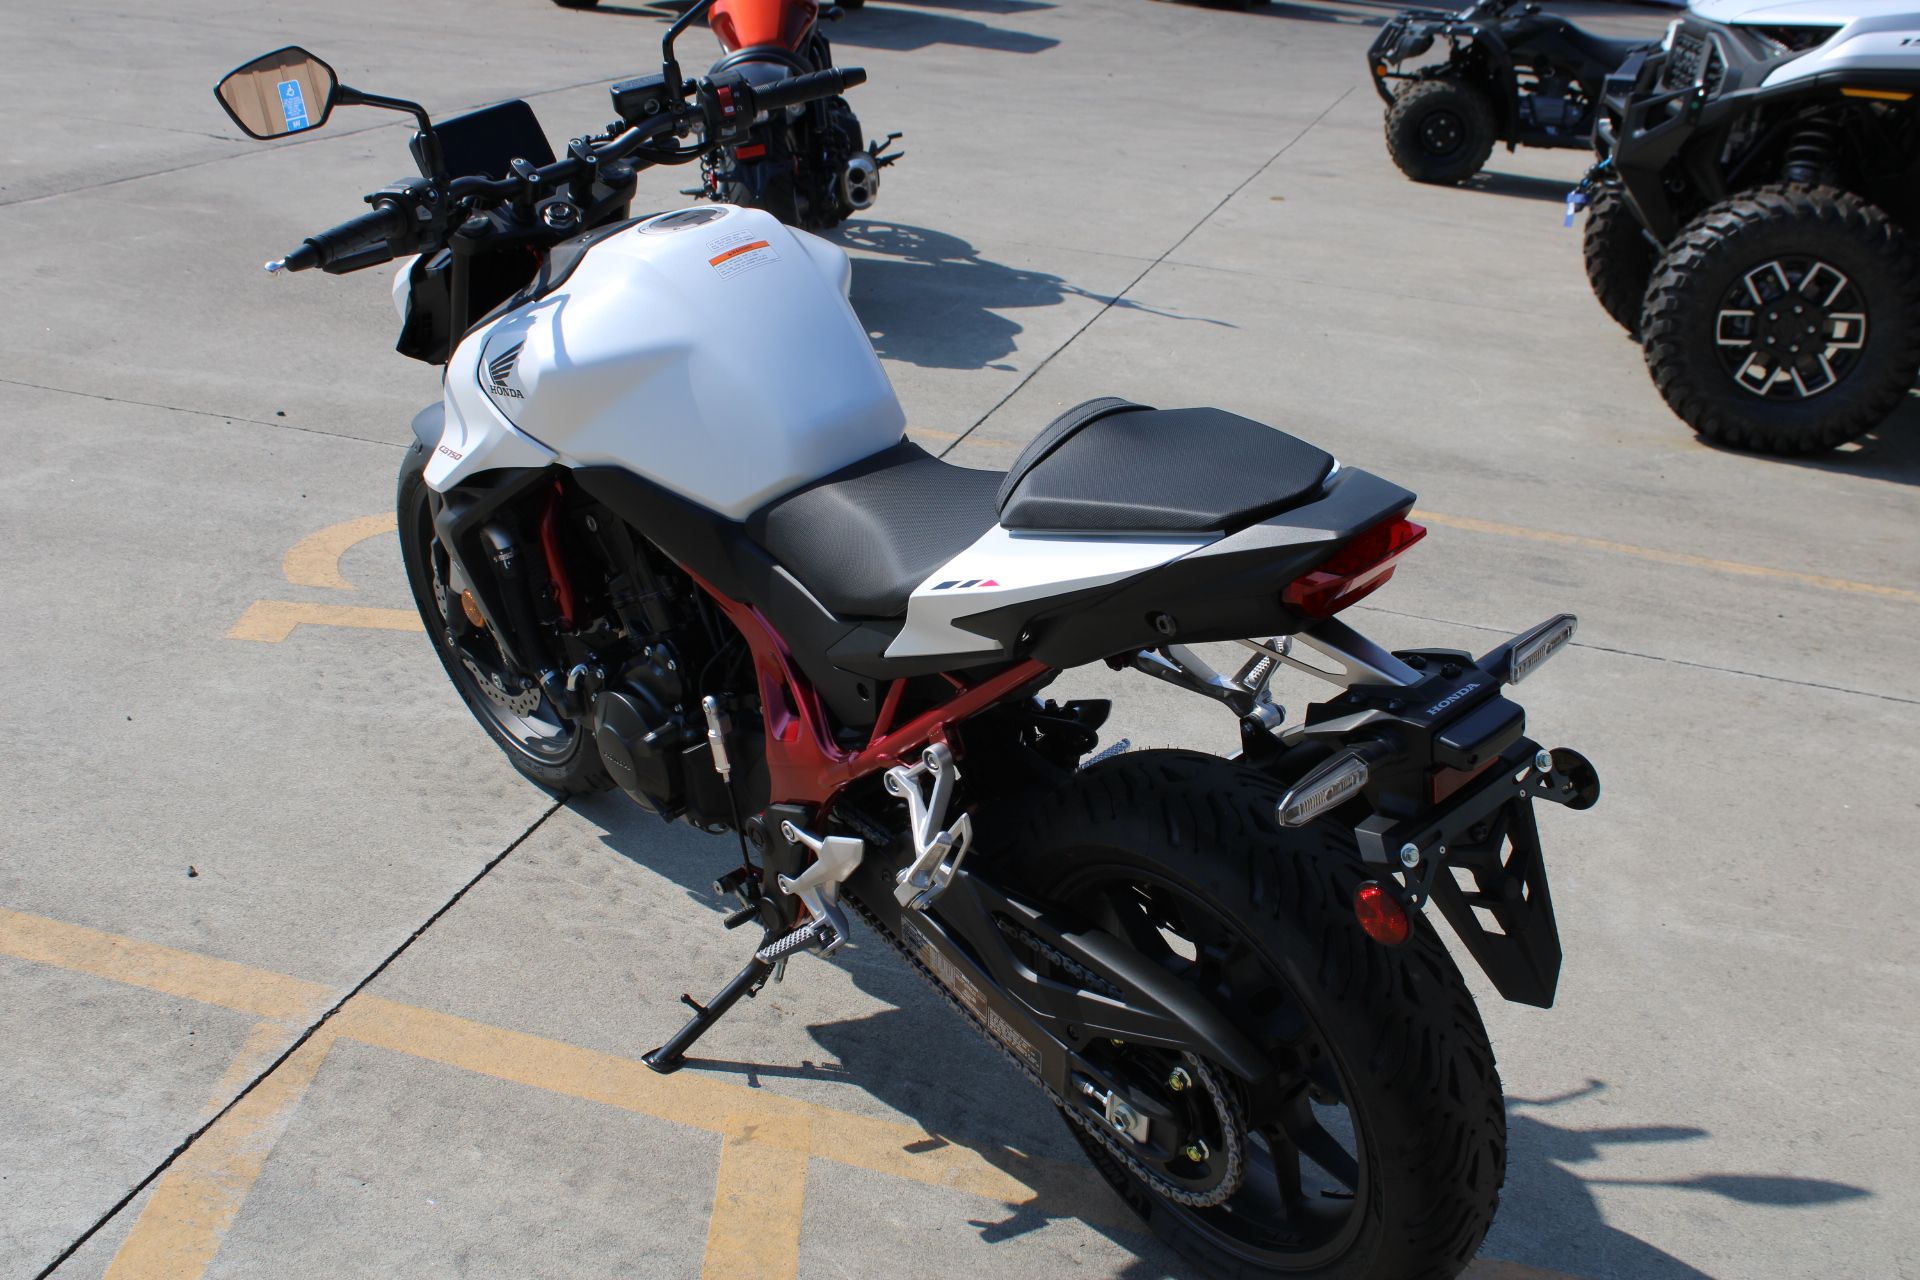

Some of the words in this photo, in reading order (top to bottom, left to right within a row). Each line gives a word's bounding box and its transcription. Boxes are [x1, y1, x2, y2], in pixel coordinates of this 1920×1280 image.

[490, 385, 525, 399] HONDA
[438, 445, 463, 461] CB750
[1426, 683, 1481, 715] HONDA
